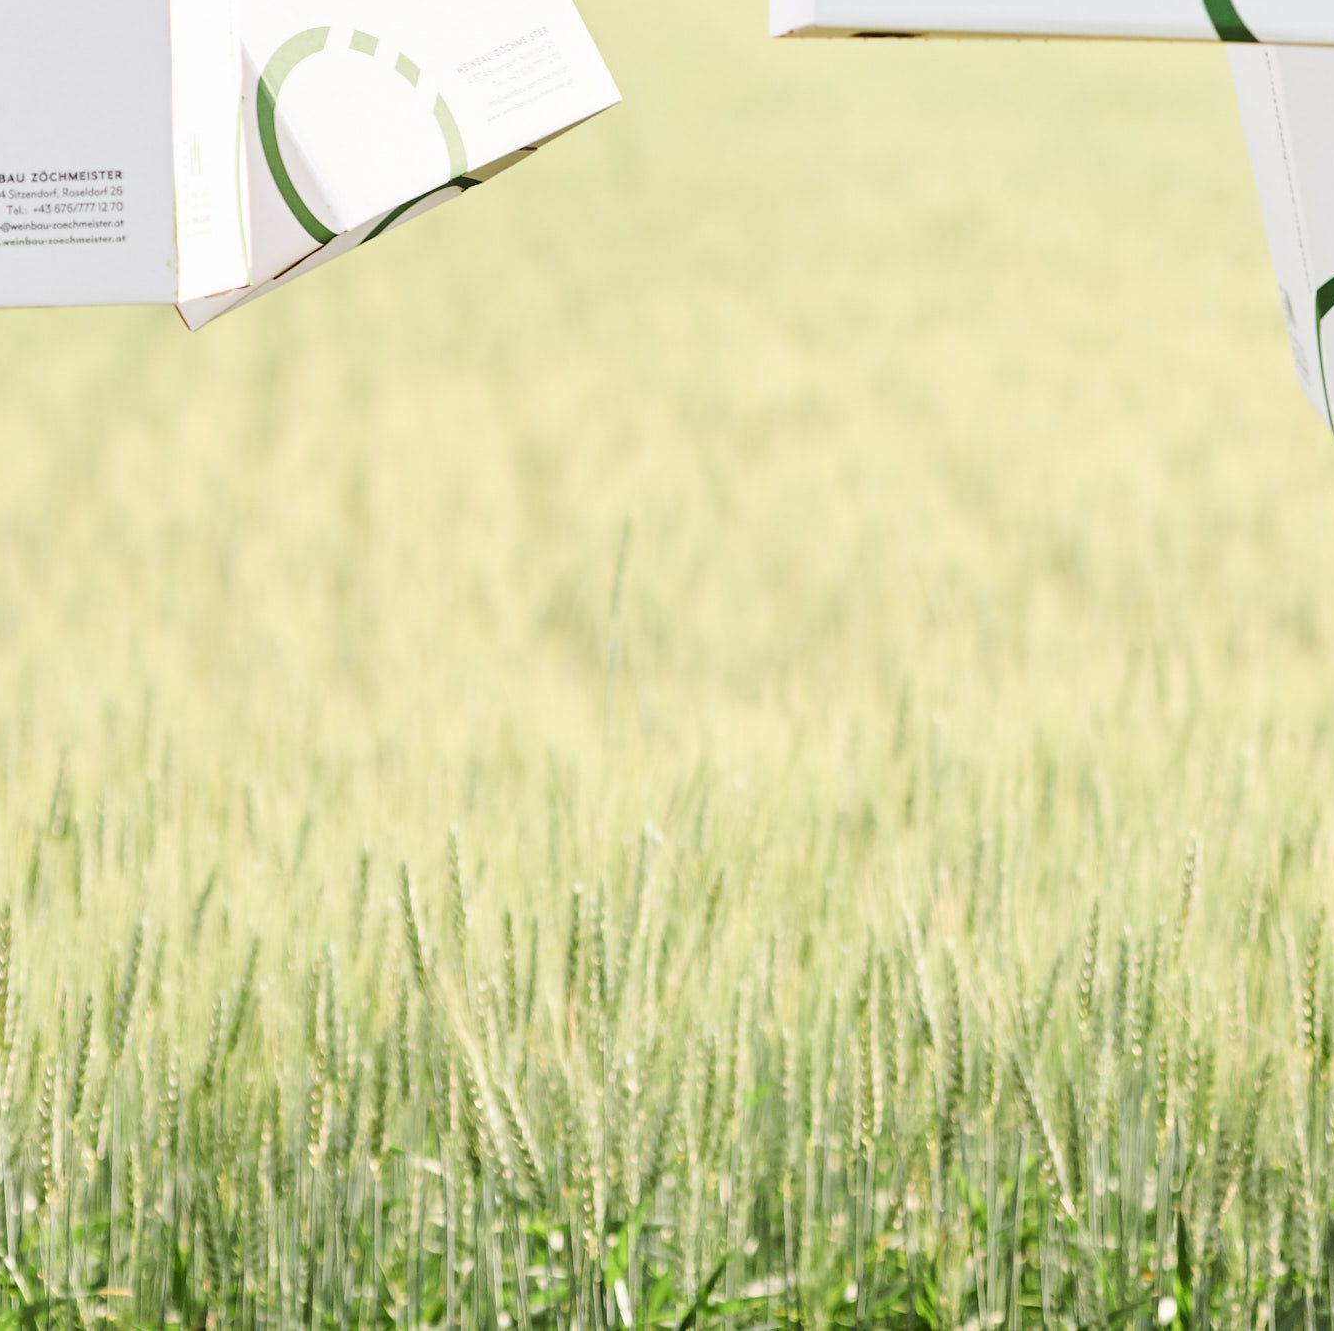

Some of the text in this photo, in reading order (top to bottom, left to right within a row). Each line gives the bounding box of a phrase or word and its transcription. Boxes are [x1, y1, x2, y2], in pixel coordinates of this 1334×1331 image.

[31, 170, 122, 183] ZÖCHMEISTER
[8, 189, 59, 200] Sitzendorf,
[62, 187, 108, 198] Roseldorf
[33, 204, 51, 214] +43
[98, 202, 108, 212] 12
[110, 202, 123, 212] 70
